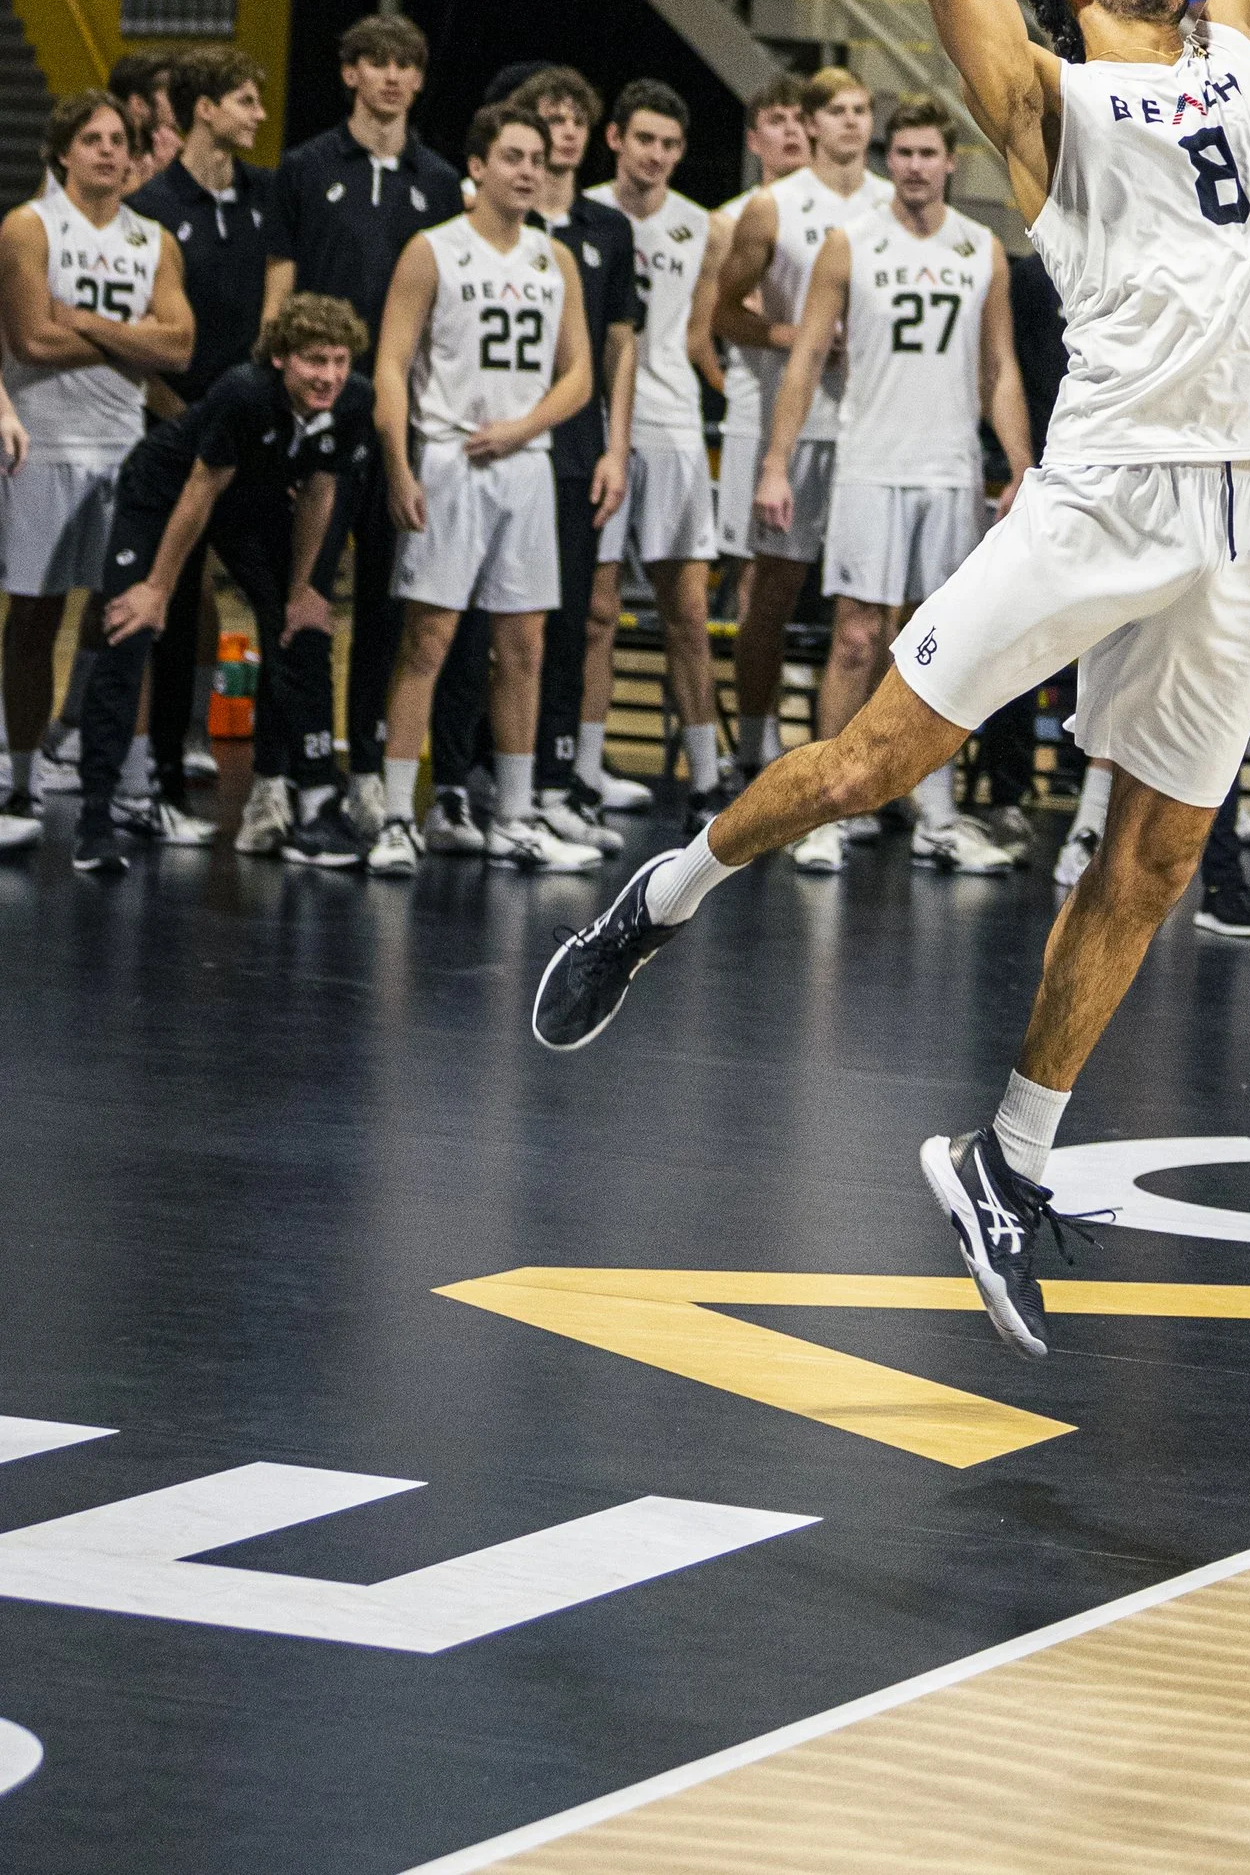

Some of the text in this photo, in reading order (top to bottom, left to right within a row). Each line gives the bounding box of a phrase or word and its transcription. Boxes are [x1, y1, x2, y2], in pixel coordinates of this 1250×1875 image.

[61, 248, 147, 281] BEACH
[874, 264, 975, 292] BEACH
[76, 276, 135, 322] 25
[460, 279, 554, 304] BEACH
[480, 307, 544, 371] 22
[892, 292, 962, 354] 27
[914, 625, 938, 666] LB
